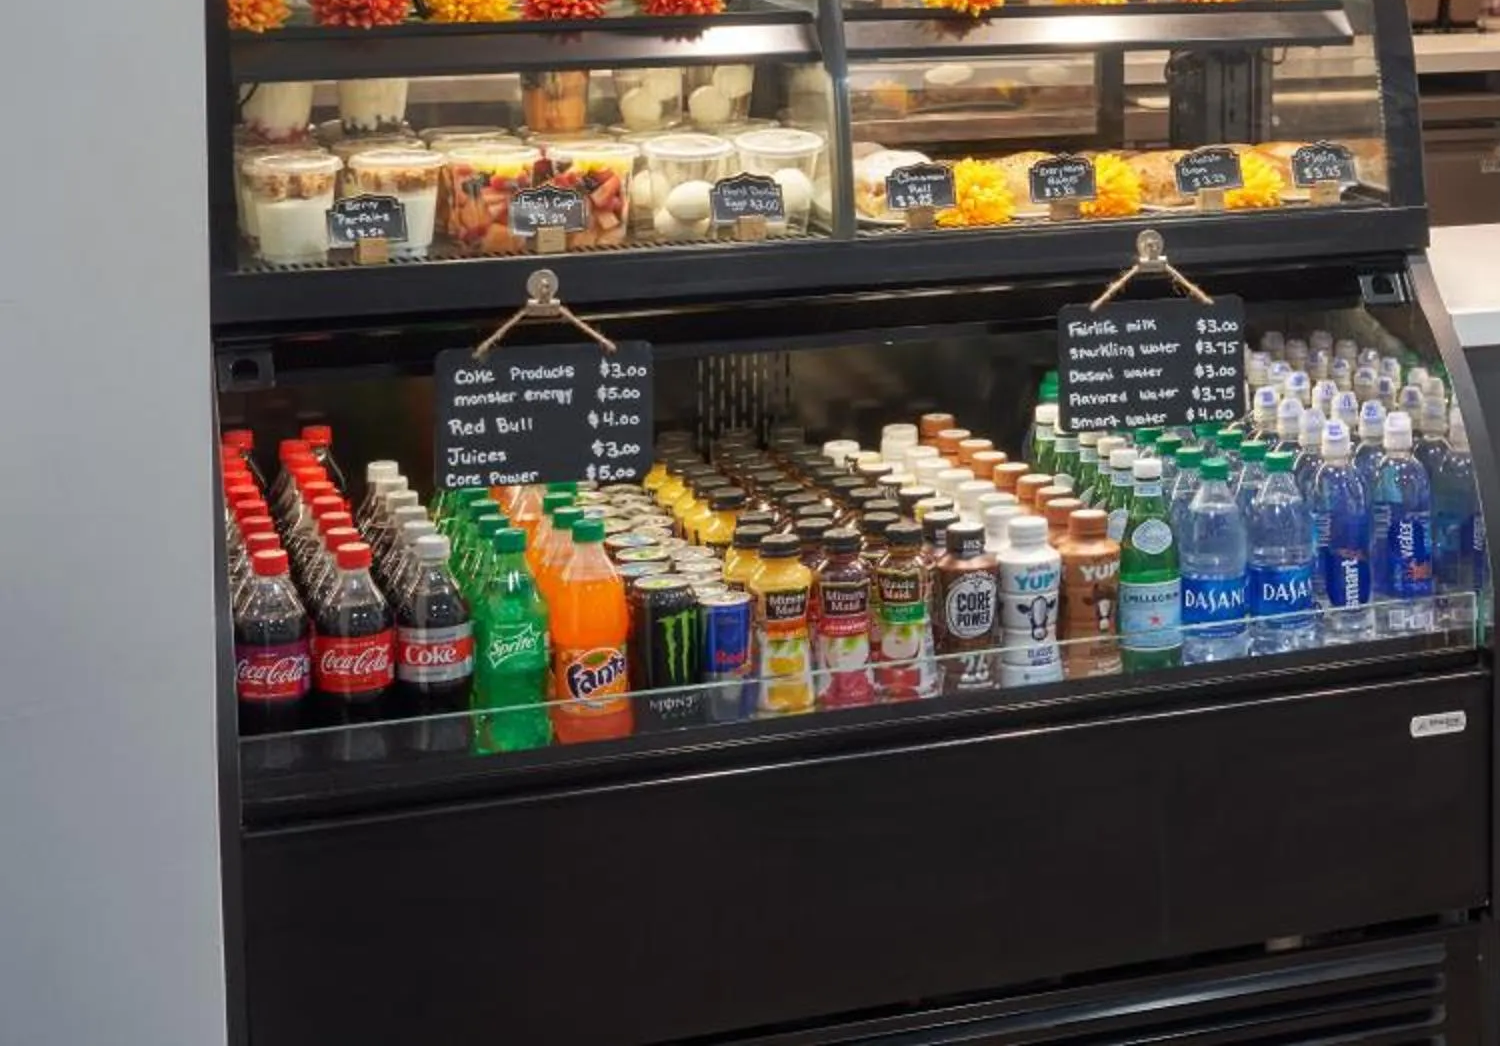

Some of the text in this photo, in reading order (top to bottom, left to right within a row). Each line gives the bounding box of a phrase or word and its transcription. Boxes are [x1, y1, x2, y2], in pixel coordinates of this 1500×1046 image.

[1197, 318, 1238, 335] $3.00
[1195, 339, 1239, 355] $3.75
[510, 365, 575, 381] Products
[600, 357, 647, 378] $3.00
[1194, 363, 1237, 379] $3.00
[454, 385, 641, 406] monster energy $5.00
[1192, 385, 1236, 401] $3.75
[448, 418, 485, 436] Red
[496, 417, 533, 434] Bull
[448, 440, 641, 466] Juices $3.00
[446, 464, 636, 487] Core Power $5.00
[957, 590, 991, 612] CORE
[1185, 588, 1245, 614] DASANI
[1263, 578, 1313, 604] DASA
[956, 611, 991, 627] POWER
[405, 644, 457, 666] Coke
[491, 634, 538, 656] Sprite
